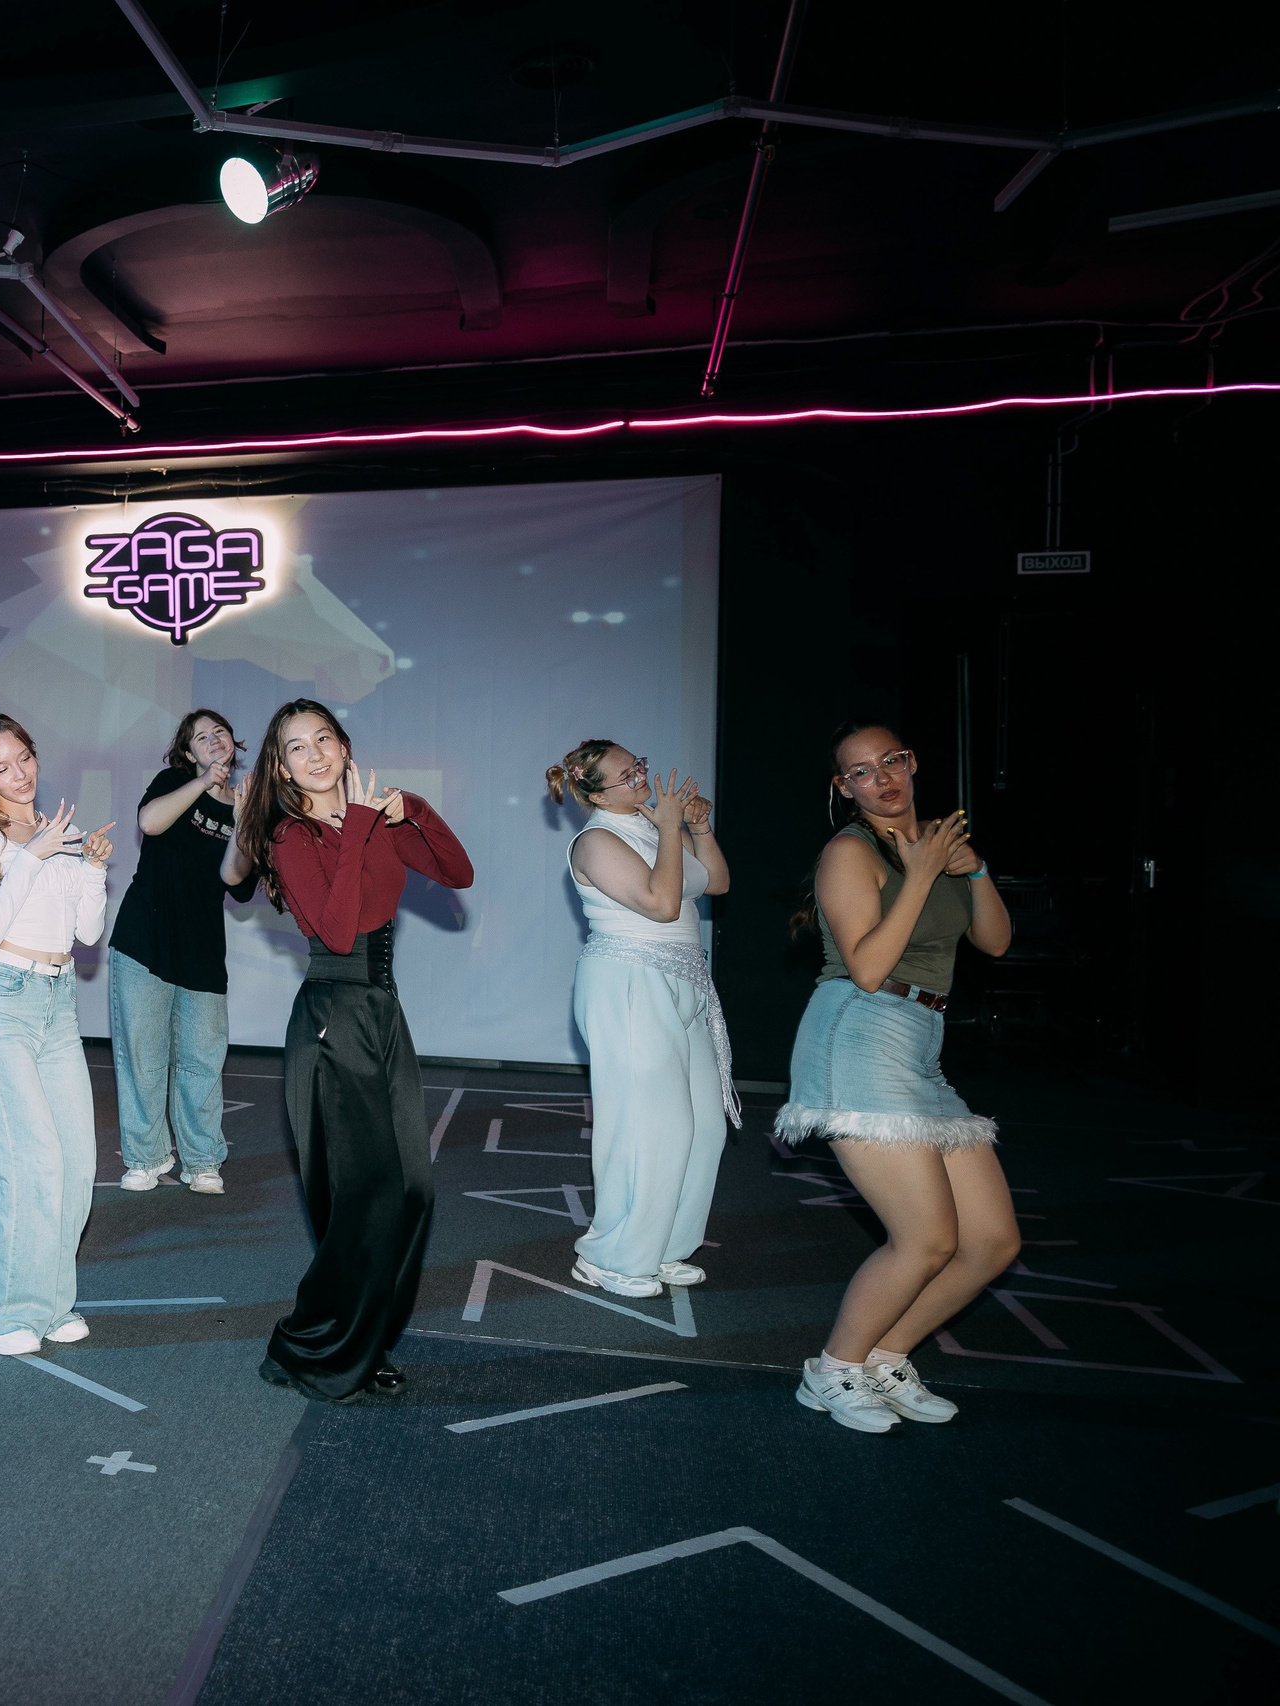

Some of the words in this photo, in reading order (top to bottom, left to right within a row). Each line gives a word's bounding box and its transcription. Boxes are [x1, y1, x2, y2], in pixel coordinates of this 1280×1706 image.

[89, 530, 260, 572] ZAGA
[1024, 556, 1083, 570] ВЫХОД
[88, 571, 261, 622] GAME
